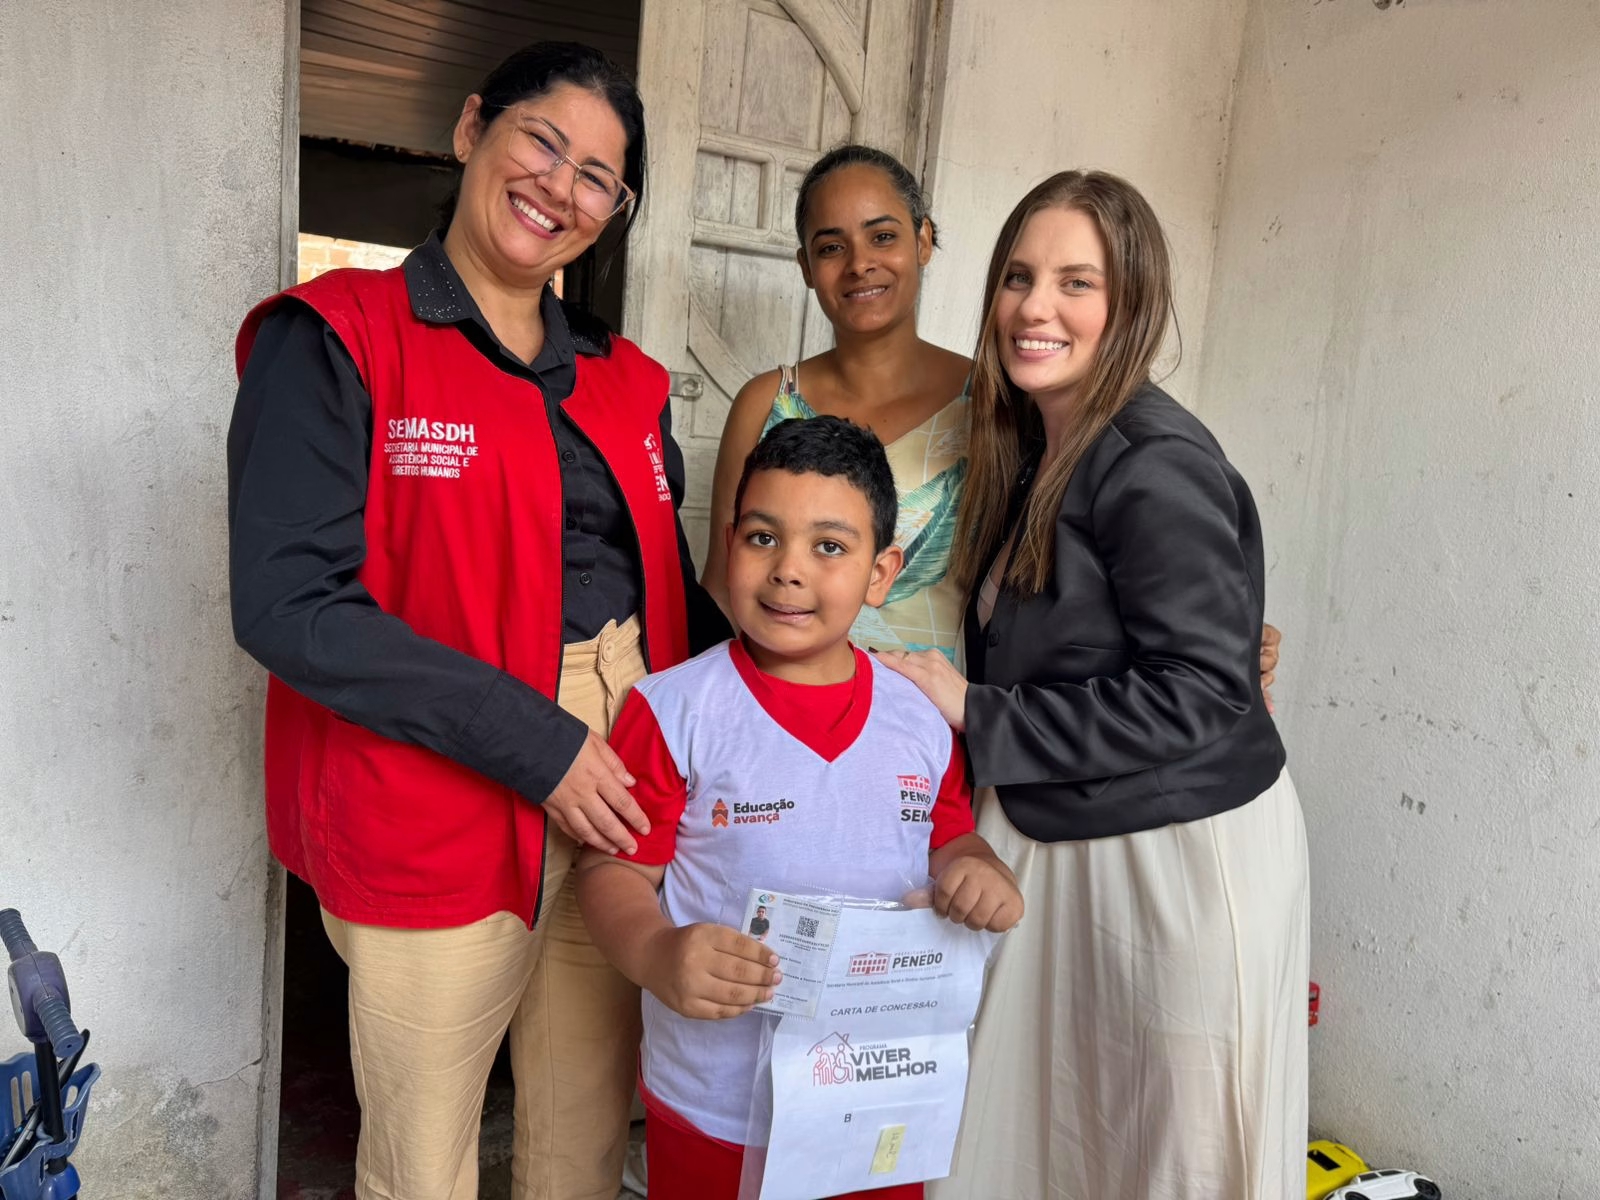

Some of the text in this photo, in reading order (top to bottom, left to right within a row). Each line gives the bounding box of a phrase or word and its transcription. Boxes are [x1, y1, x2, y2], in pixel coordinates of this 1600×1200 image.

[388, 417, 475, 443] SEMASDH
[420, 442, 466, 456] MUNICIPAL
[466, 446, 479, 456] DE
[430, 454, 461, 467] SOCIAL
[463, 457, 470, 467] E
[420, 466, 461, 479] HUMANOS
[733, 798, 795, 813] Educação
[733, 813, 780, 824] avança
[892, 952, 943, 969] PENEDO
[830, 1000, 938, 1017] CARTA DE CONCESSÃO
[859, 1043, 887, 1051] PROGRAMA
[850, 1047, 911, 1066] VIVER
[856, 1060, 938, 1083] MELHOR
[844, 1113, 852, 1123] B
